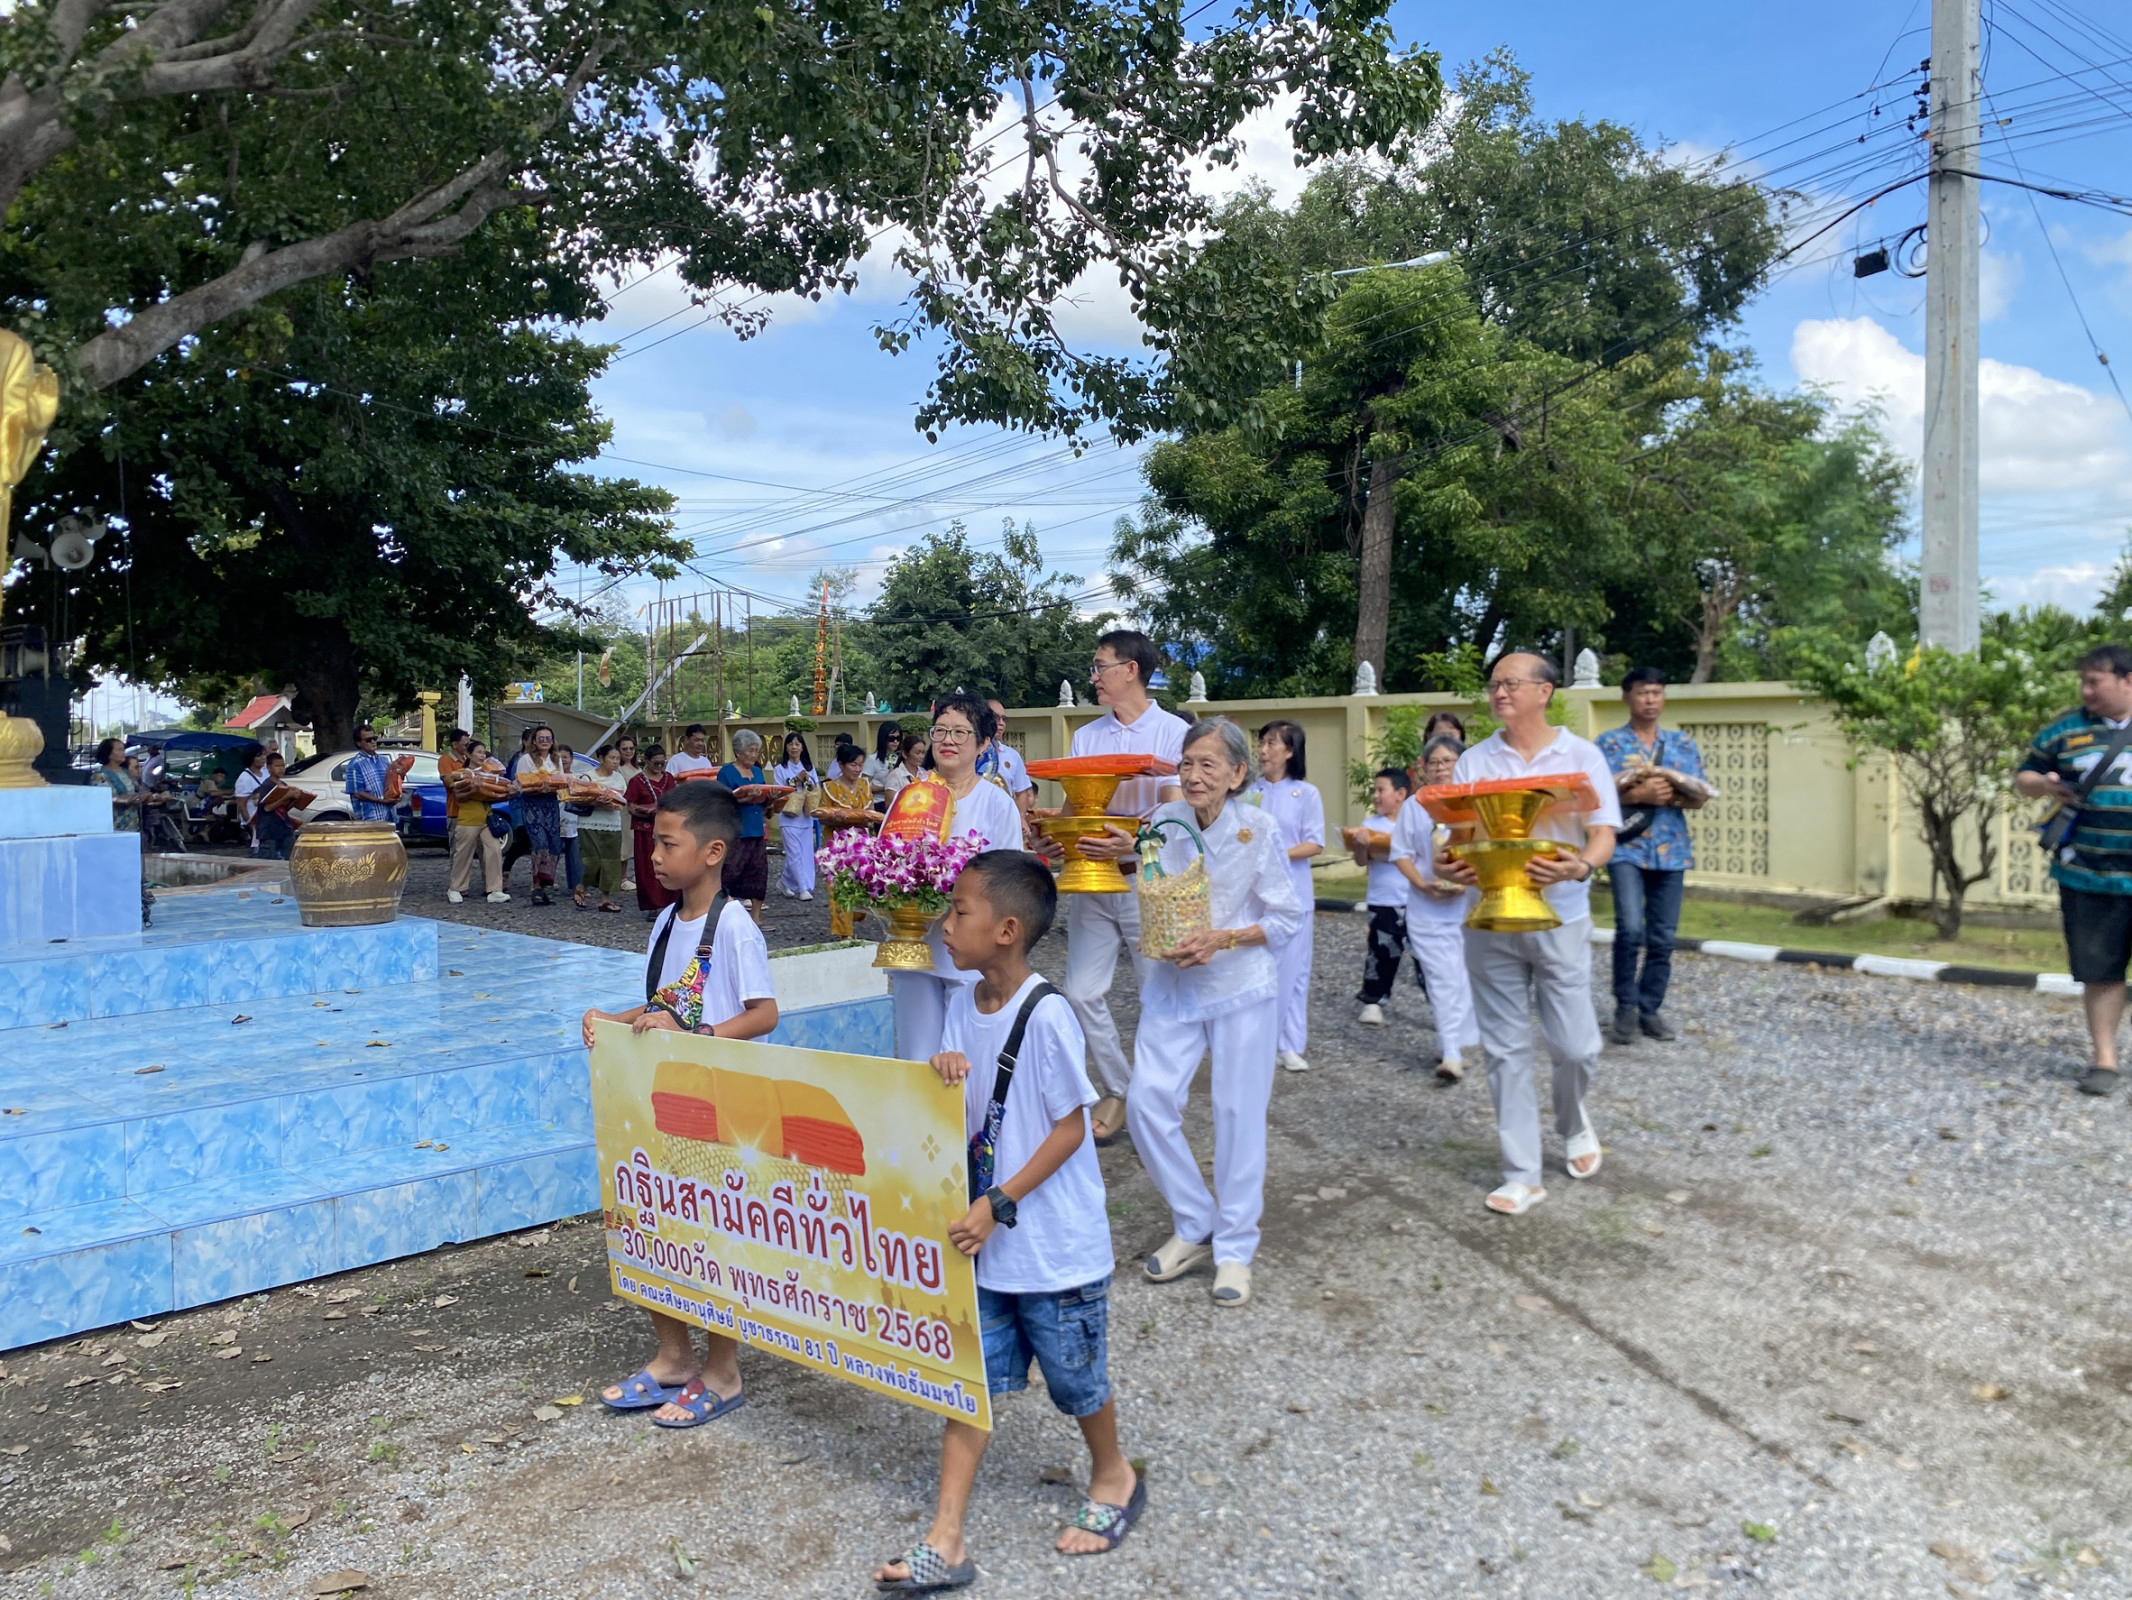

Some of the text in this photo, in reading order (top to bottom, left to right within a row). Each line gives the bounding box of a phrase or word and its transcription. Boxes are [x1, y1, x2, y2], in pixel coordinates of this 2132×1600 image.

[616, 1151, 941, 1289] กฐินสามัคคีทั่วไทย
[615, 1267, 977, 1414] โดย คณะศิษยานุศิษย์ บูชาธรรม 81 ปี หลวงพ่อธัมมชโย
[728, 1266, 867, 1333] พุทธศักราช
[875, 1306, 951, 1360] 2568
